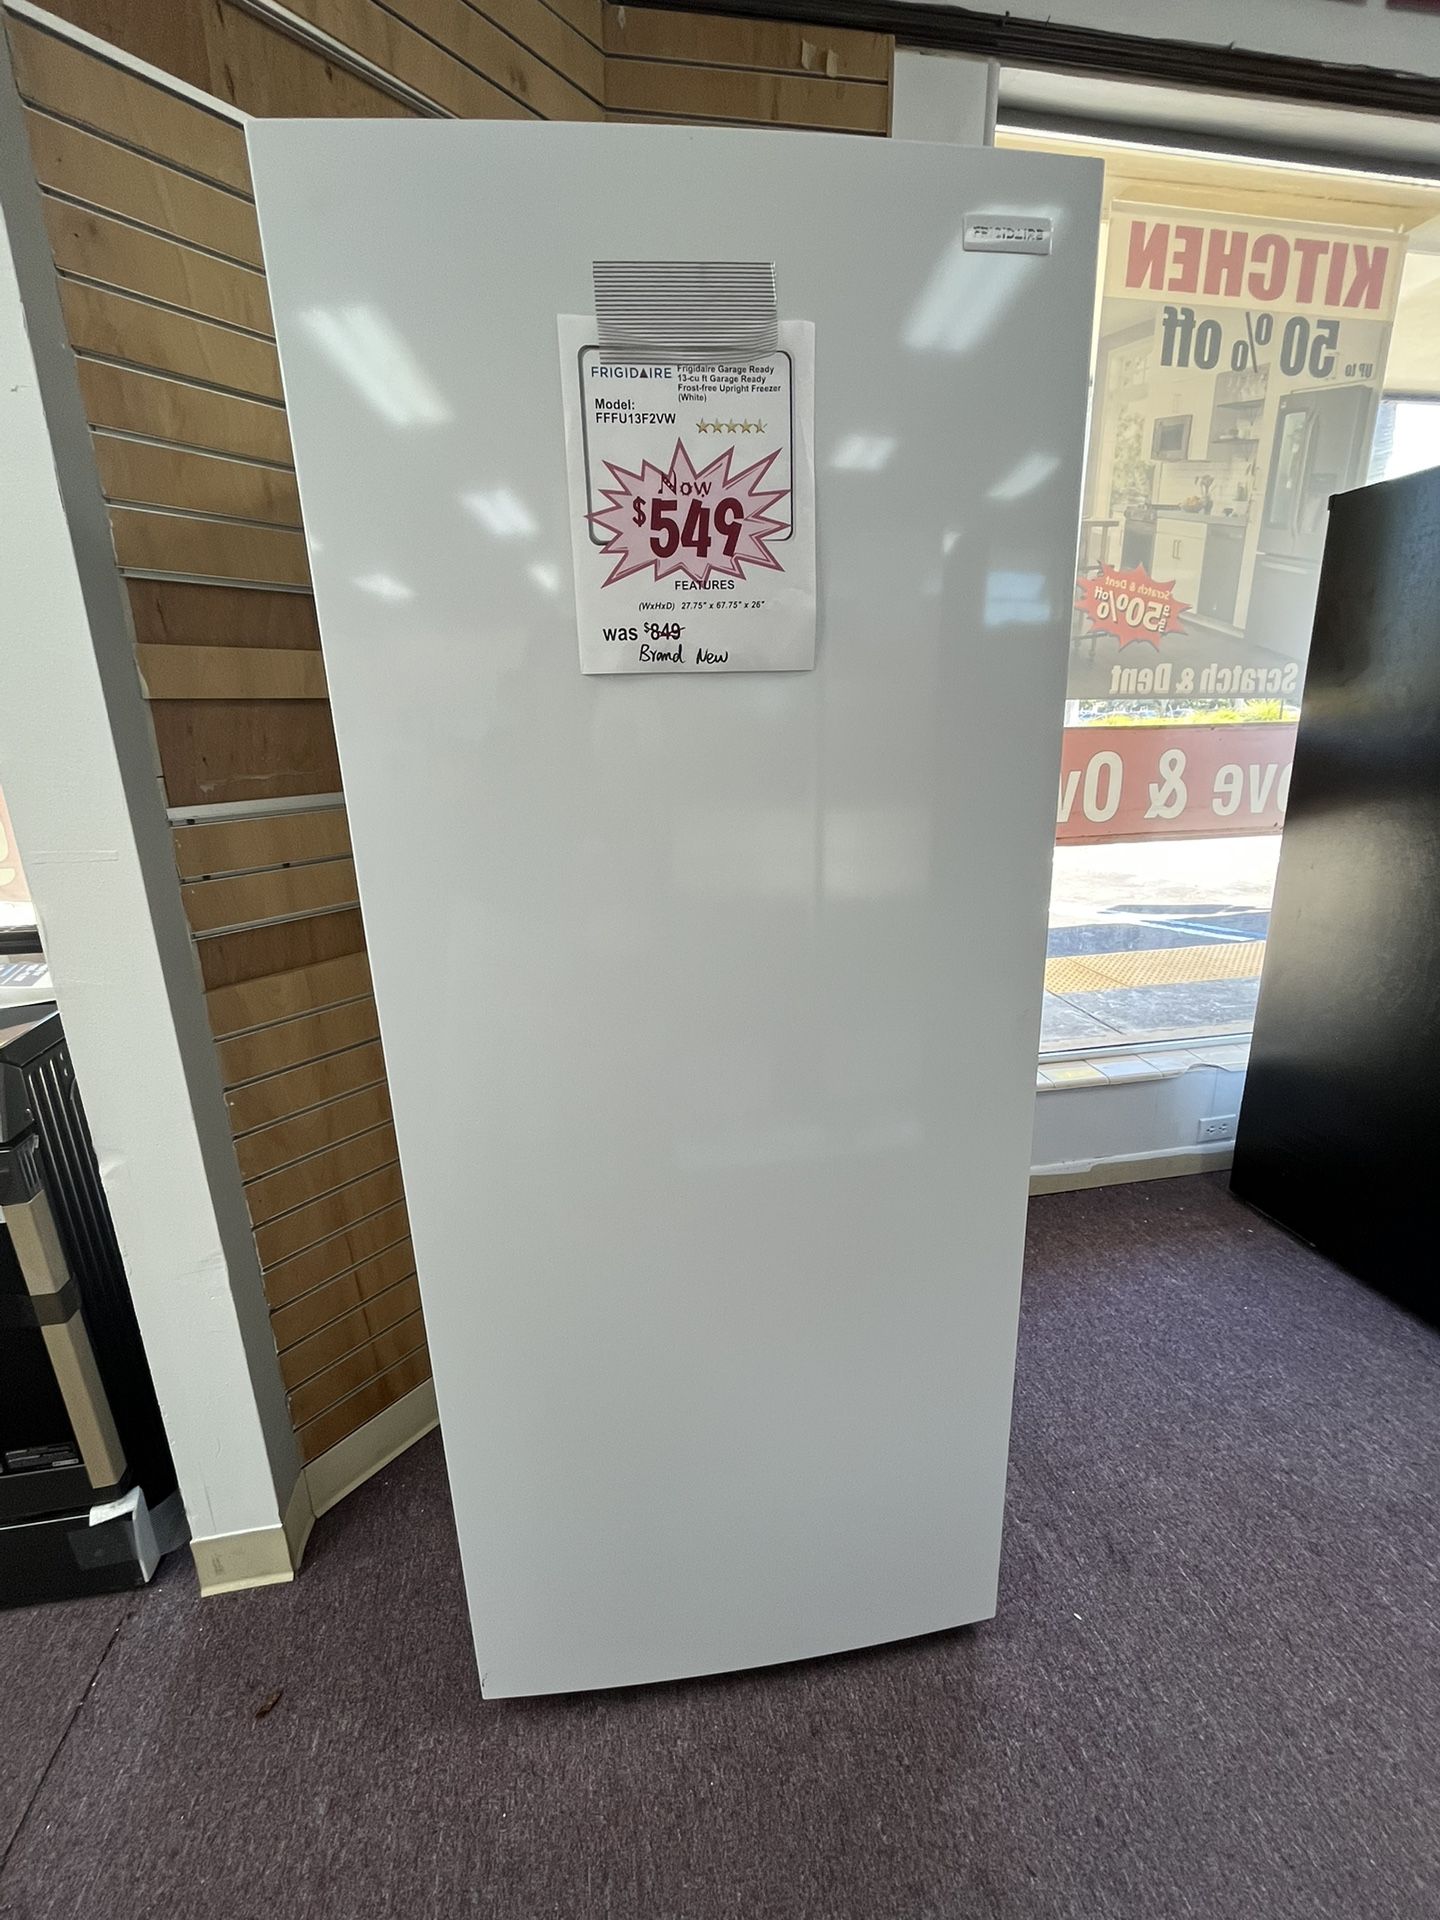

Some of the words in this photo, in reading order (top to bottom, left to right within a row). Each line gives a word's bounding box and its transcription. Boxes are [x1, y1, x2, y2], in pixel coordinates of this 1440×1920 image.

[591, 366, 672, 379] FRIGIDAIRE
[677, 365, 716, 374] Frigidaire
[717, 366, 747, 375] Garage
[749, 366, 775, 375] Ready
[678, 374, 700, 383] 13-cu
[702, 374, 708, 382] ft
[710, 375, 739, 384] Garage
[741, 375, 767, 385] Ready
[678, 384, 717, 392] Frost-free
[720, 384, 750, 394] Upright
[751, 385, 781, 393] Freezer
[678, 393, 707, 402] (White)
[595, 398, 635, 410] Model:
[595, 412, 676, 424] FFFU13F2VW
[658, 469, 712, 497] Now
[632, 497, 745, 558] $549
[674, 580, 735, 590] FEATURES
[638, 602, 675, 612] (WxHxD)
[681, 601, 707, 609] 27.75"
[716, 600, 742, 609] 67.75"
[751, 600, 765, 608] 26"
[602, 628, 638, 641] was
[643, 621, 685, 641] $849
[639, 643, 685, 662] Brand
[696, 647, 729, 664] New
